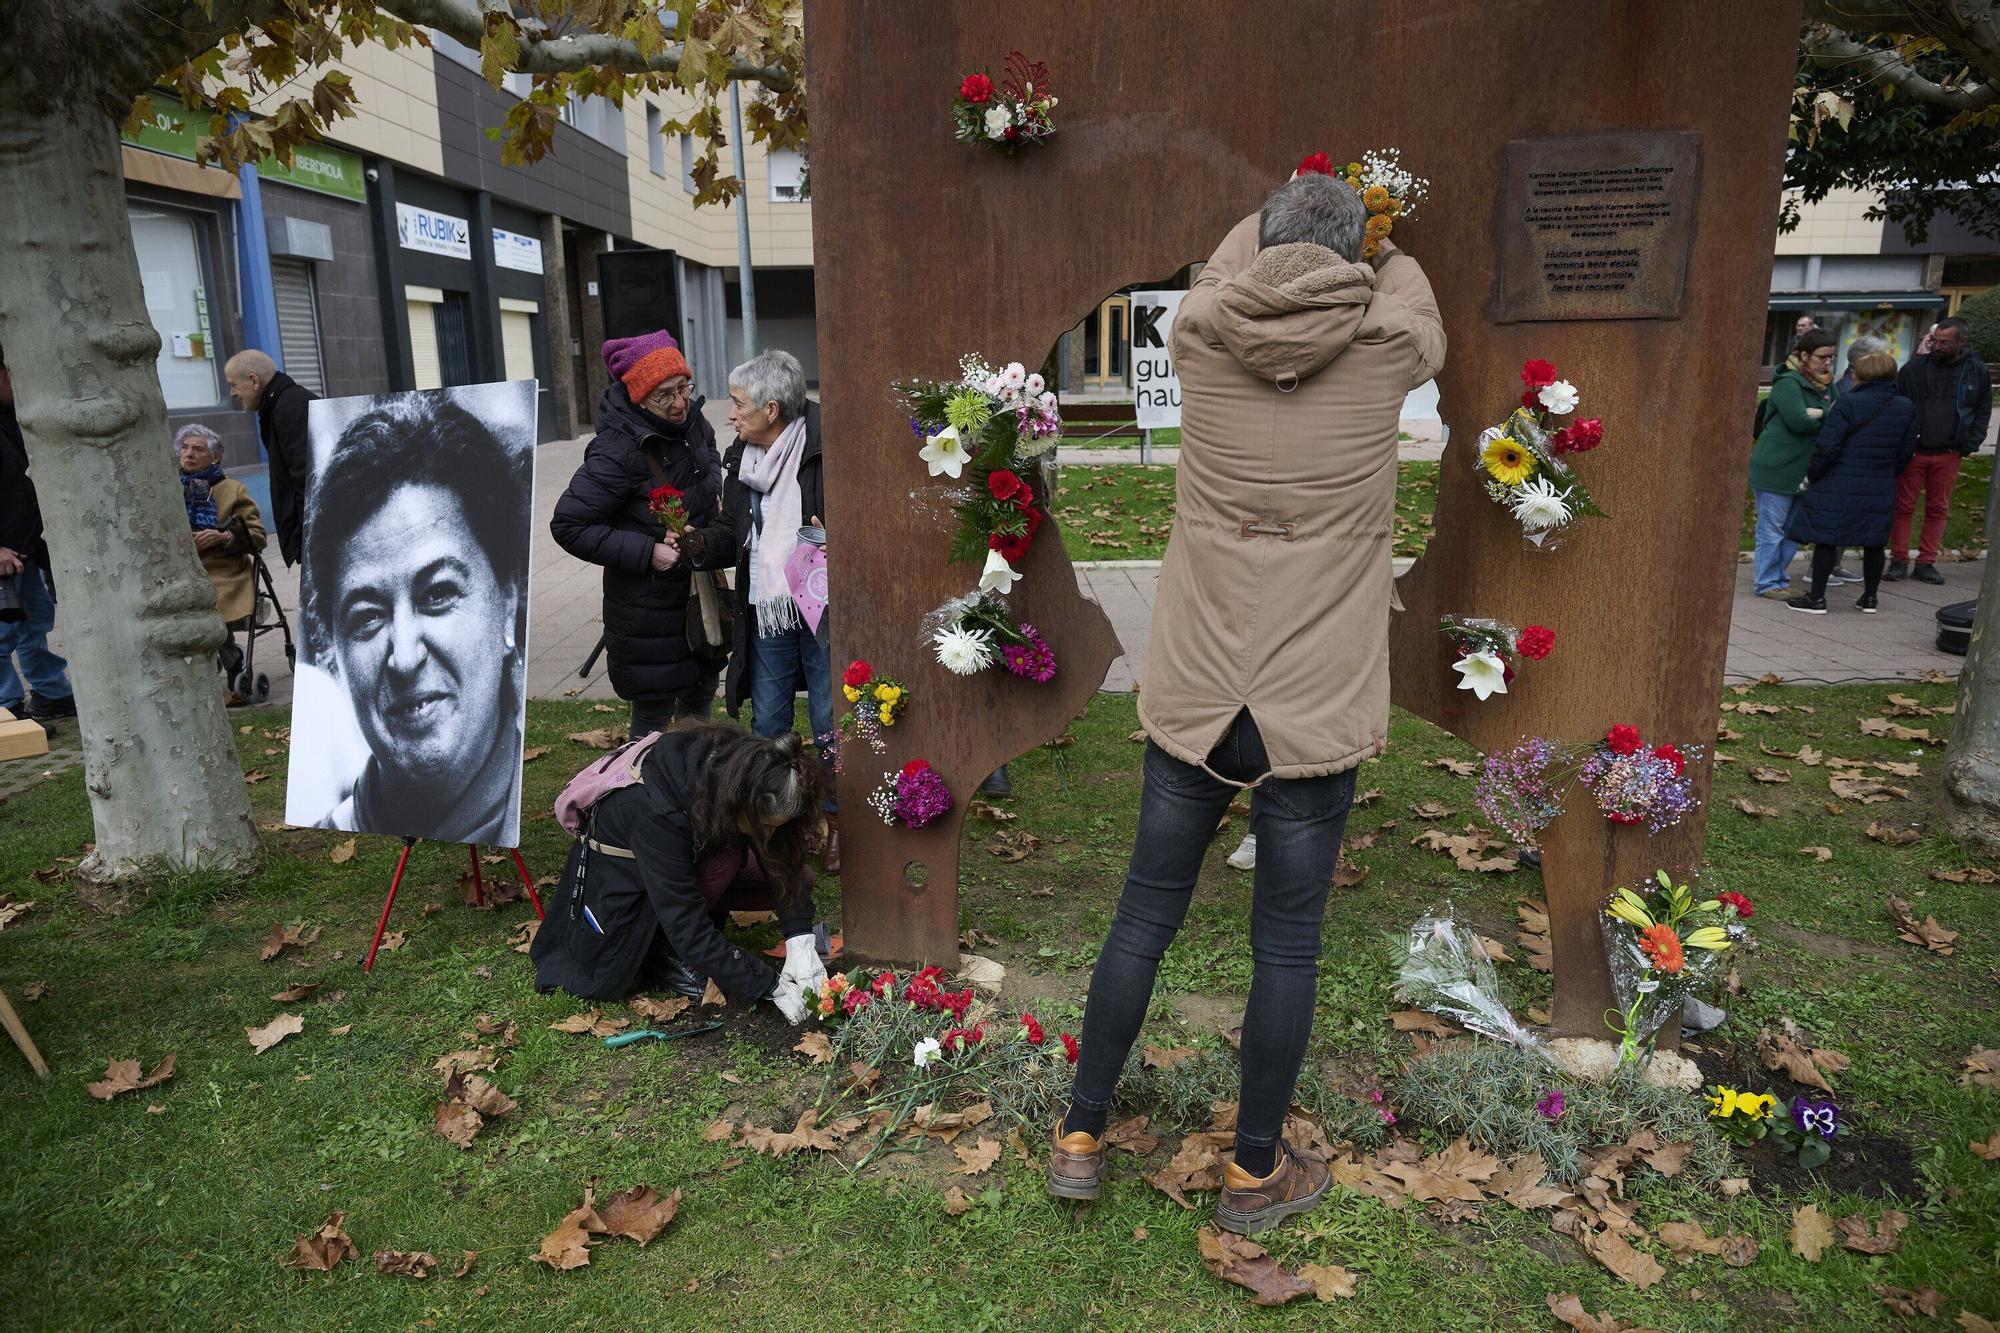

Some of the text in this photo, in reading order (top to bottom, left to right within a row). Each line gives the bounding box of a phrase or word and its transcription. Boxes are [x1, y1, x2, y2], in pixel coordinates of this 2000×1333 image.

[295, 154, 344, 181] IBERDROLA
[418, 214, 457, 243] RUBIK
[1133, 305, 1168, 348] K
